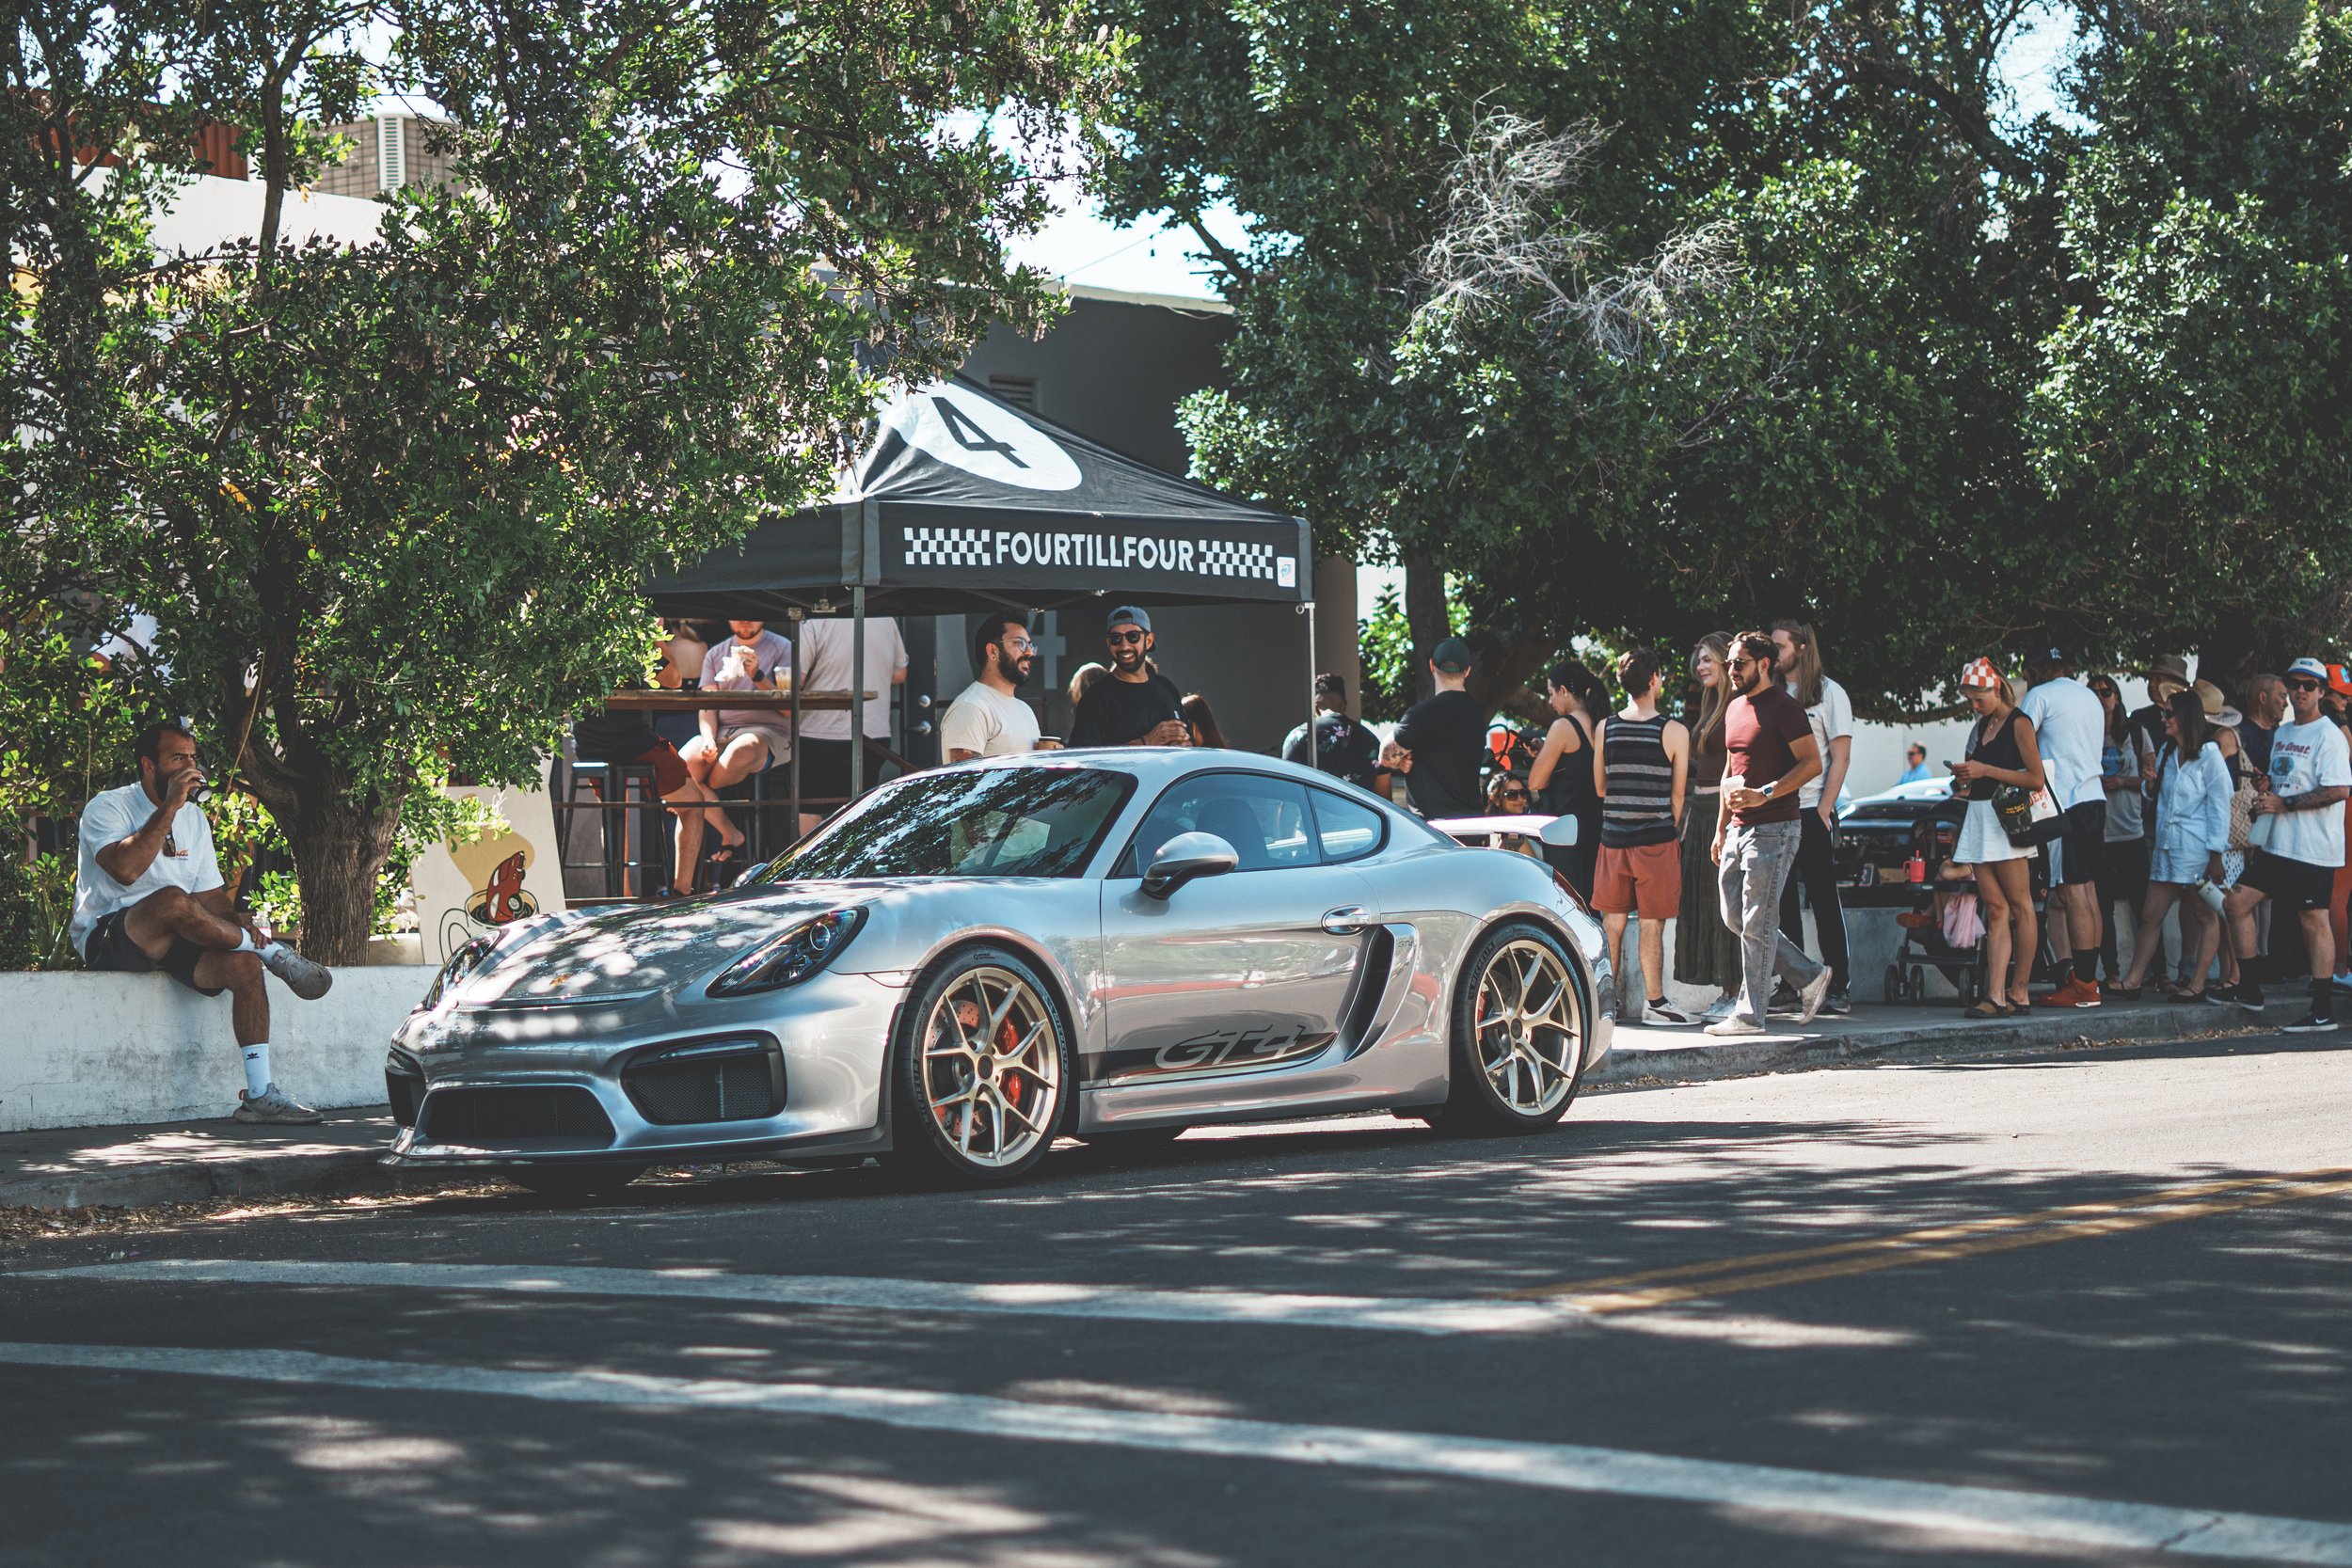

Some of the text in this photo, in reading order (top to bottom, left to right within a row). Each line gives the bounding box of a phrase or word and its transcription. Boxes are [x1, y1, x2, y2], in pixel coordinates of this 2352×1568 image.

[930, 396, 1031, 468] 4
[995, 531, 1194, 572] FOURTILLFOUR
[1398, 940, 1413, 948] GT4
[1470, 942, 1494, 987] MICHELIN
[1154, 1024, 1306, 1069] GT4
